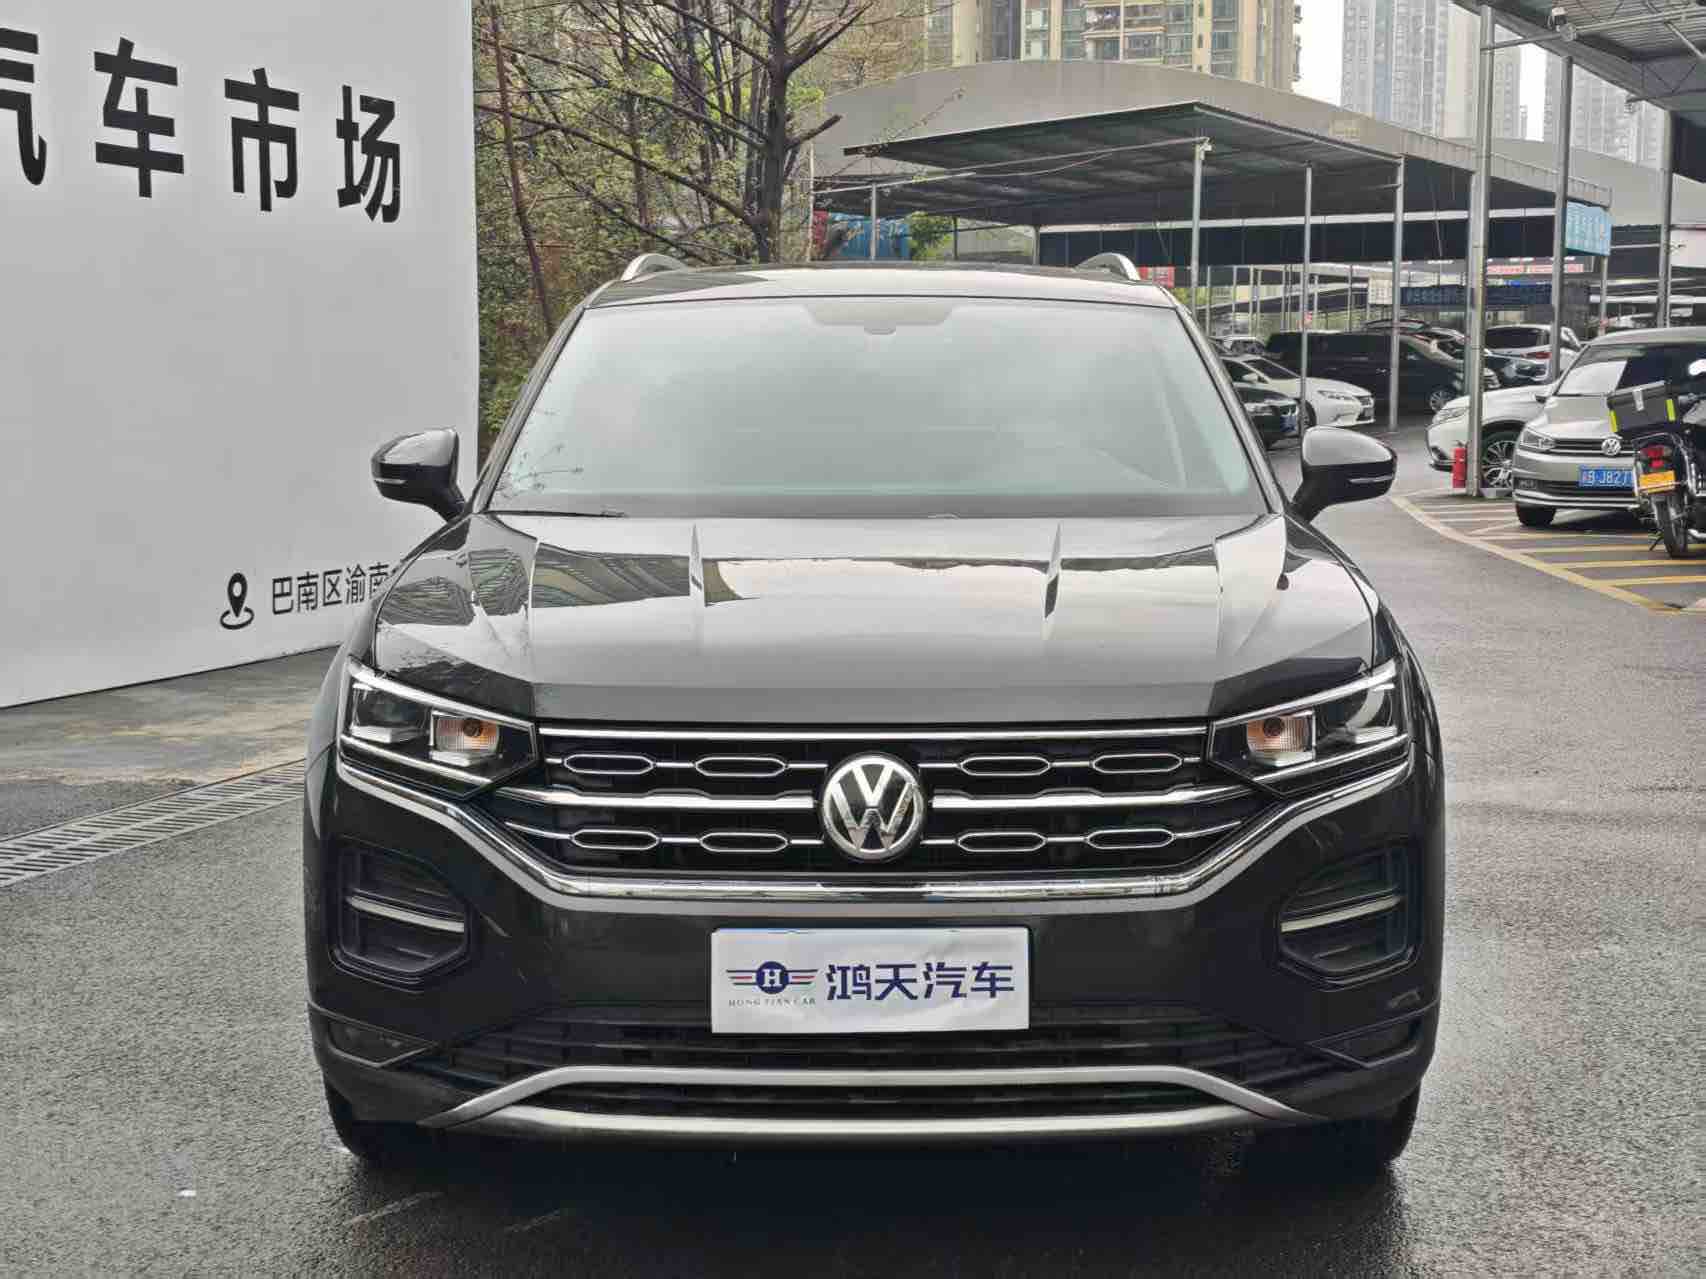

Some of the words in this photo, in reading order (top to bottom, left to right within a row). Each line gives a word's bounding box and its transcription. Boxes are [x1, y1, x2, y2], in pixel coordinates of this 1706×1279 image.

[272, 562, 398, 615] 巴南区渝南
[826, 961, 1015, 1001] 鸿天汽车
